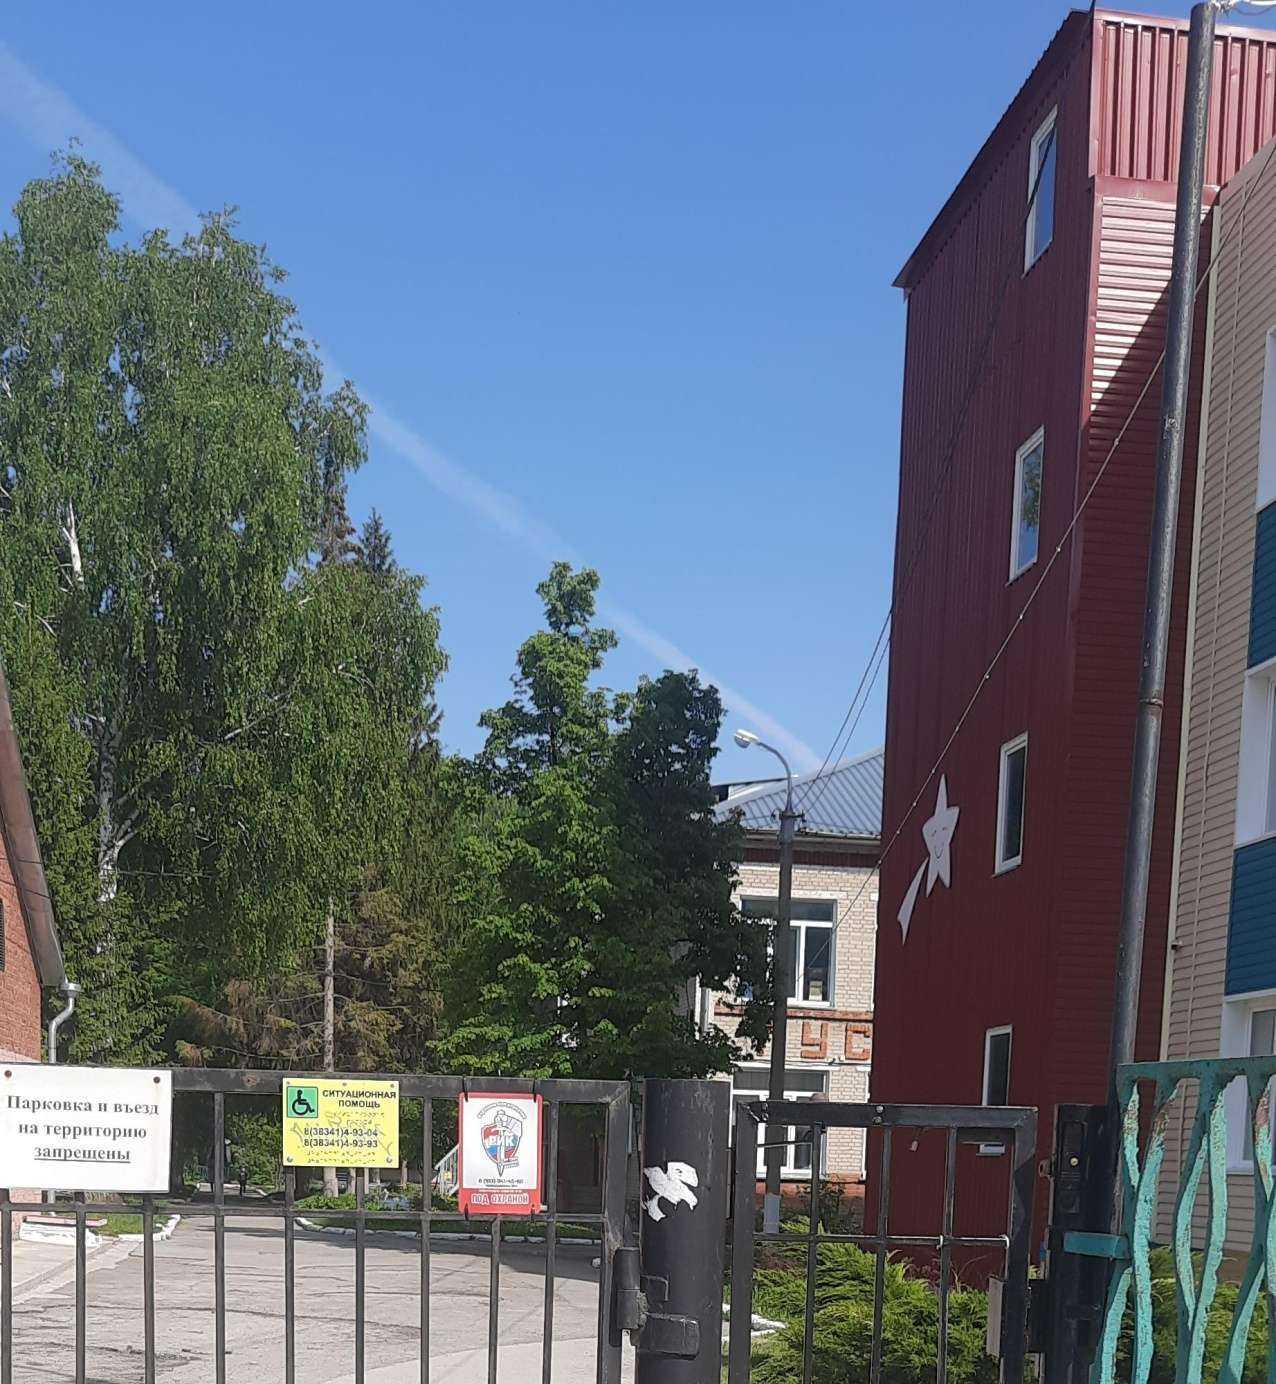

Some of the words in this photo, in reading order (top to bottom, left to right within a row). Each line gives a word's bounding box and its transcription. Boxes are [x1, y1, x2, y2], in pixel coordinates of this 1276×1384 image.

[322, 1089, 397, 1099] СИТУАЦИОННАЯ
[7, 1095, 93, 1113] Парковка
[97, 1103, 109, 1113] и
[113, 1103, 160, 1115] въезд
[338, 1099, 381, 1109] ПОМОЩЬ
[18, 1123, 39, 1135] на
[44, 1124, 147, 1141] территорию
[304, 1127, 378, 1138] 8(38341)4-93-04
[304, 1138, 378, 1149] 8(38341)4-93-93
[34, 1146, 132, 1162] запрещены
[471, 1193, 490, 1205] ПОД
[490, 1193, 529, 1205] ОХРАНОЙ
